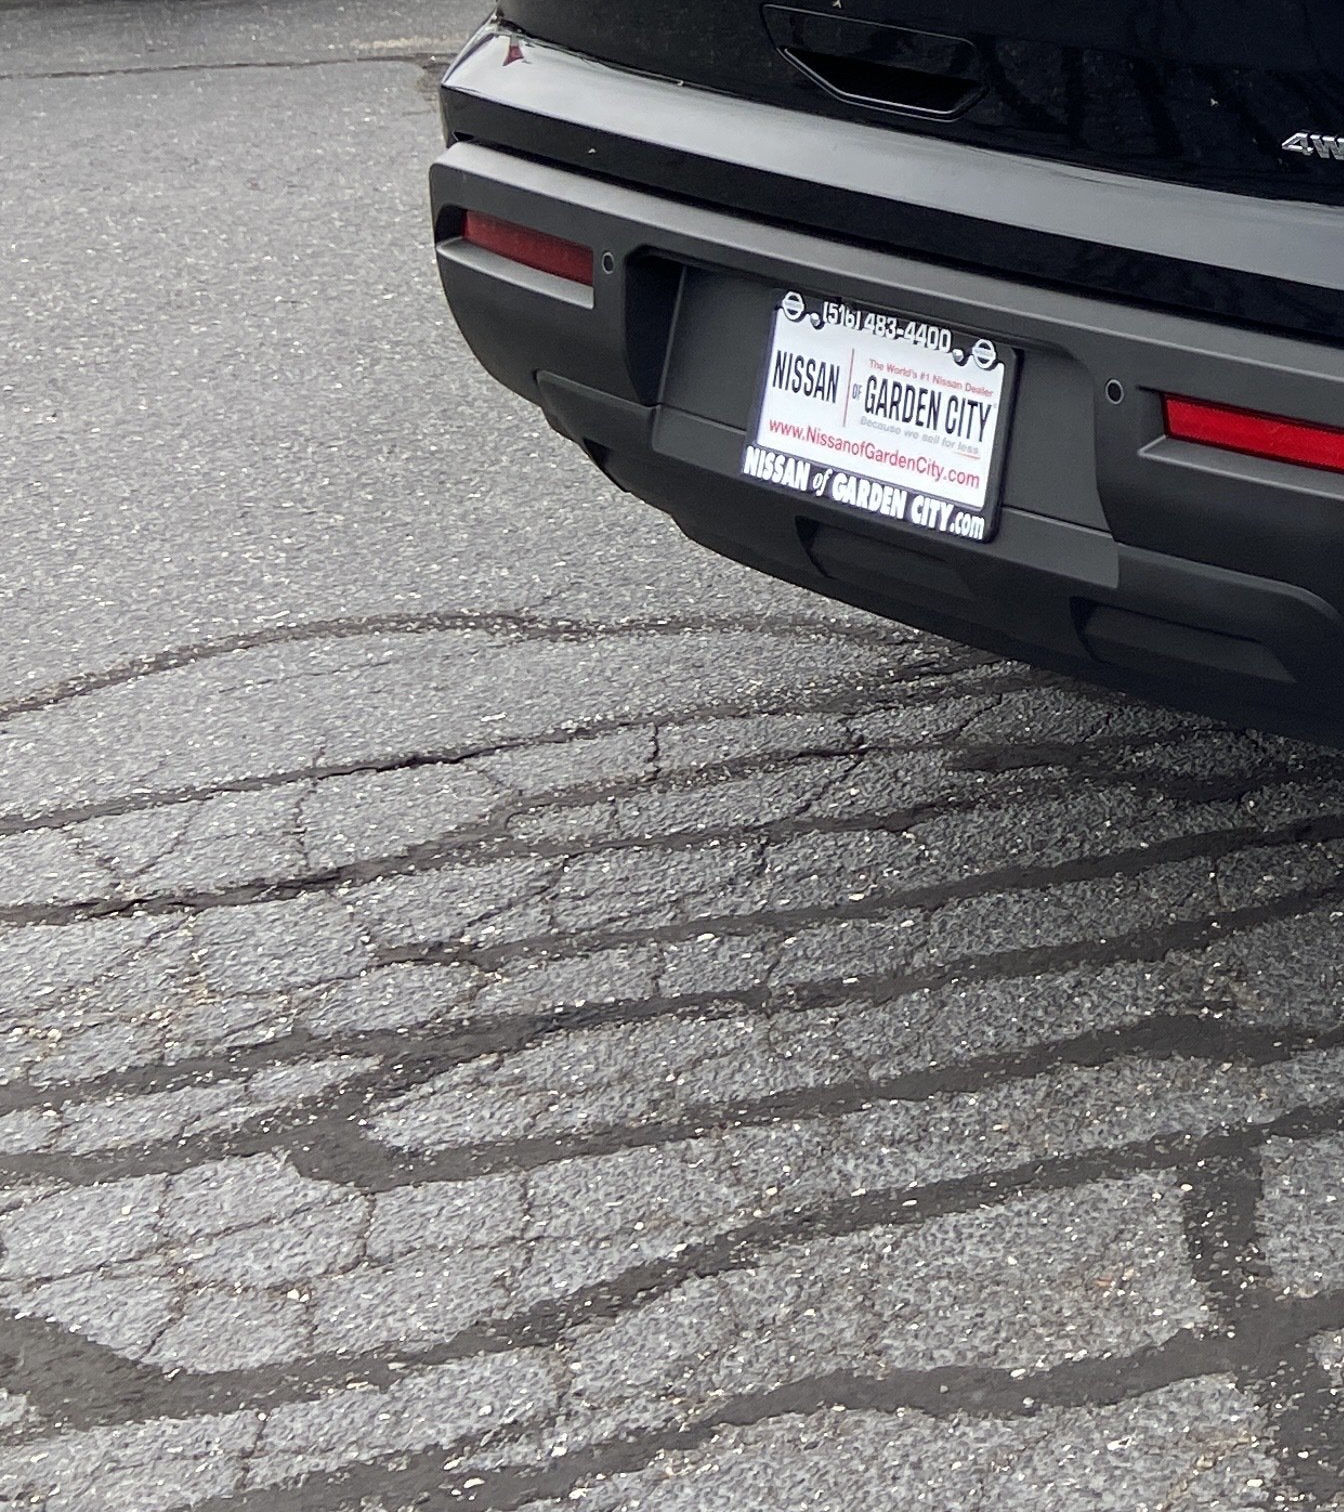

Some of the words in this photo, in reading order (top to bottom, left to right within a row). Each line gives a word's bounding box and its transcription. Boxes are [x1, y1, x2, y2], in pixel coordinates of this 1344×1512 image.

[822, 300, 862, 332] (516)
[864, 312, 952, 354] 483-4400
[772, 350, 840, 404] NISSAN
[864, 374, 942, 431] GARDEN
[944, 394, 992, 442] CITY
[869, 359, 884, 370] The
[886, 362, 917, 379] World's
[919, 372, 930, 382] #1
[932, 375, 962, 390] Nissan
[964, 382, 994, 397] Dealer
[743, 444, 811, 491] NISSAN
[812, 468, 834, 497] of
[832, 472, 908, 519] GARDEN
[769, 418, 980, 489] www.NissanofGardenCity.com
